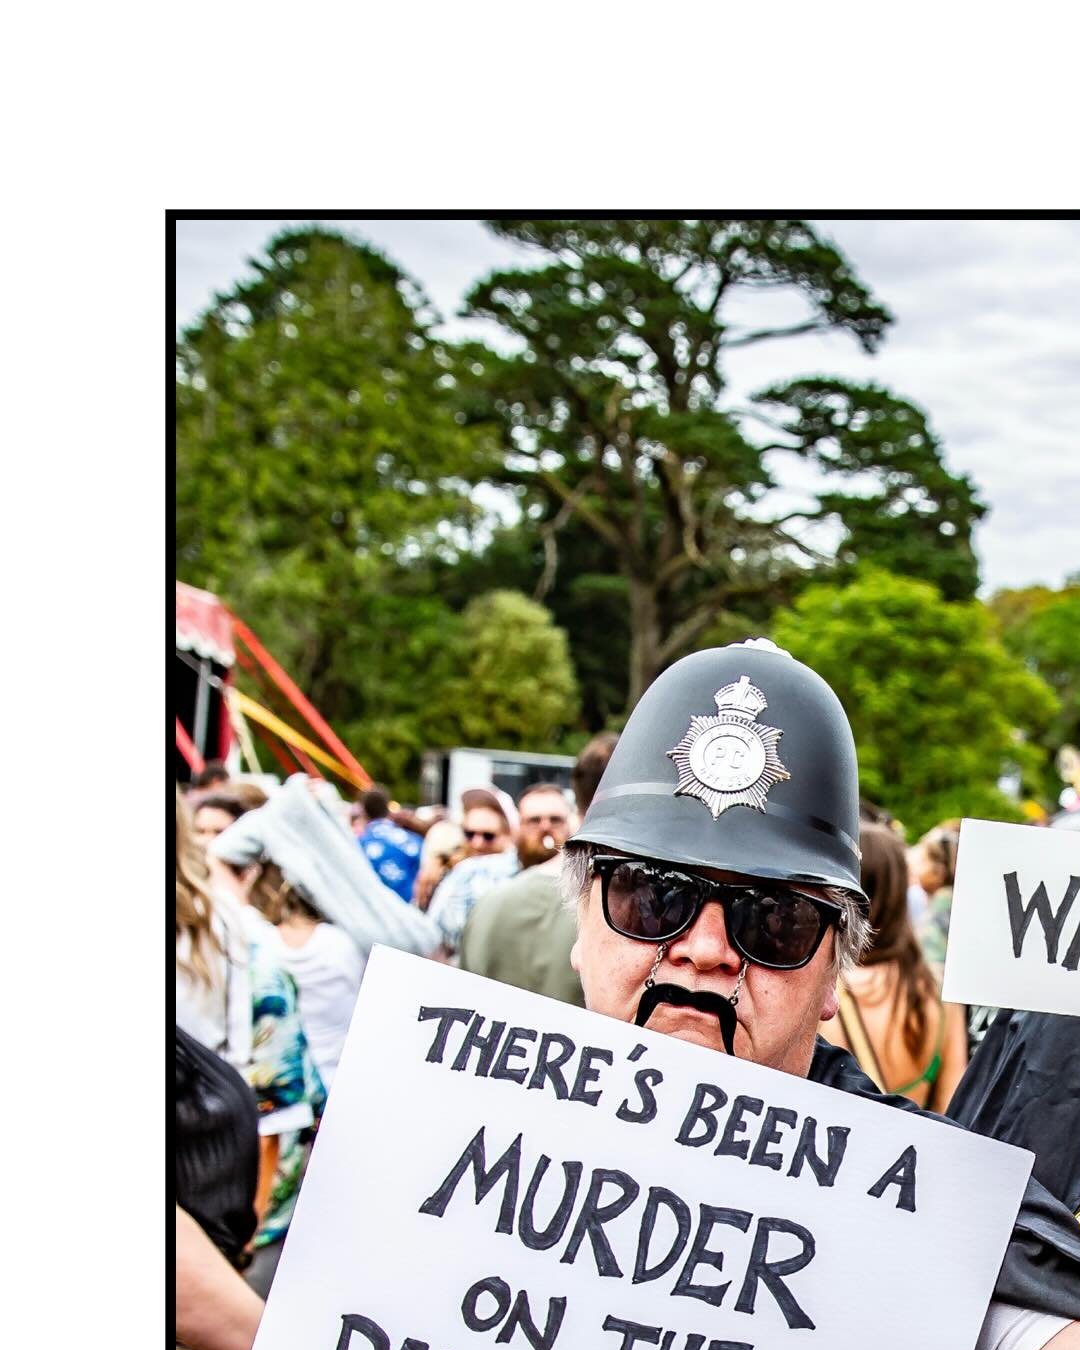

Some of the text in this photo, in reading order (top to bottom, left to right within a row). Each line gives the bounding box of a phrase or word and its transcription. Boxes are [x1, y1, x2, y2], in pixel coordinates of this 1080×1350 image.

[417, 1005, 917, 1214] THERE'S BEEN A
[418, 1125, 817, 1331] MURDER
